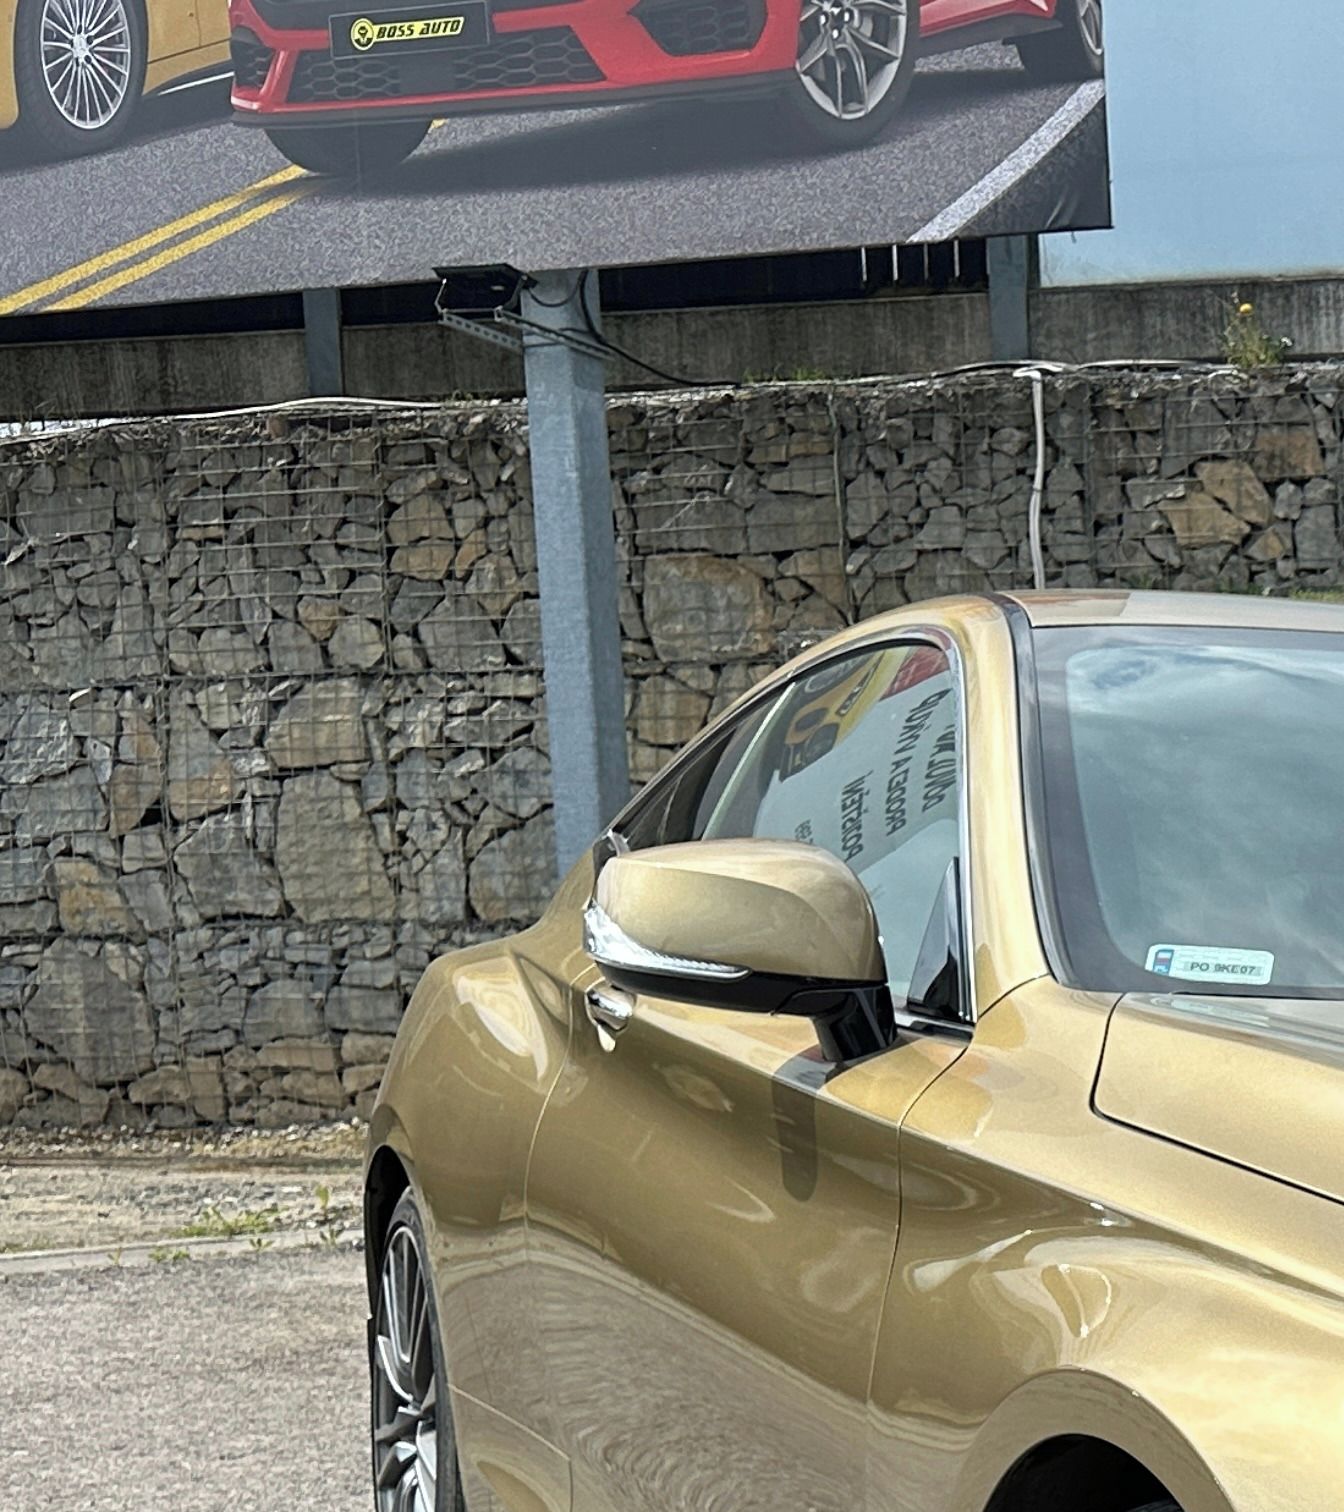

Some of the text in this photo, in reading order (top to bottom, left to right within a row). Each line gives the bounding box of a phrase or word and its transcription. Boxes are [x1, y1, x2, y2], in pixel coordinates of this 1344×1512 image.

[377, 19, 461, 39] BOSS AUTO
[1190, 962, 1210, 972] PO
